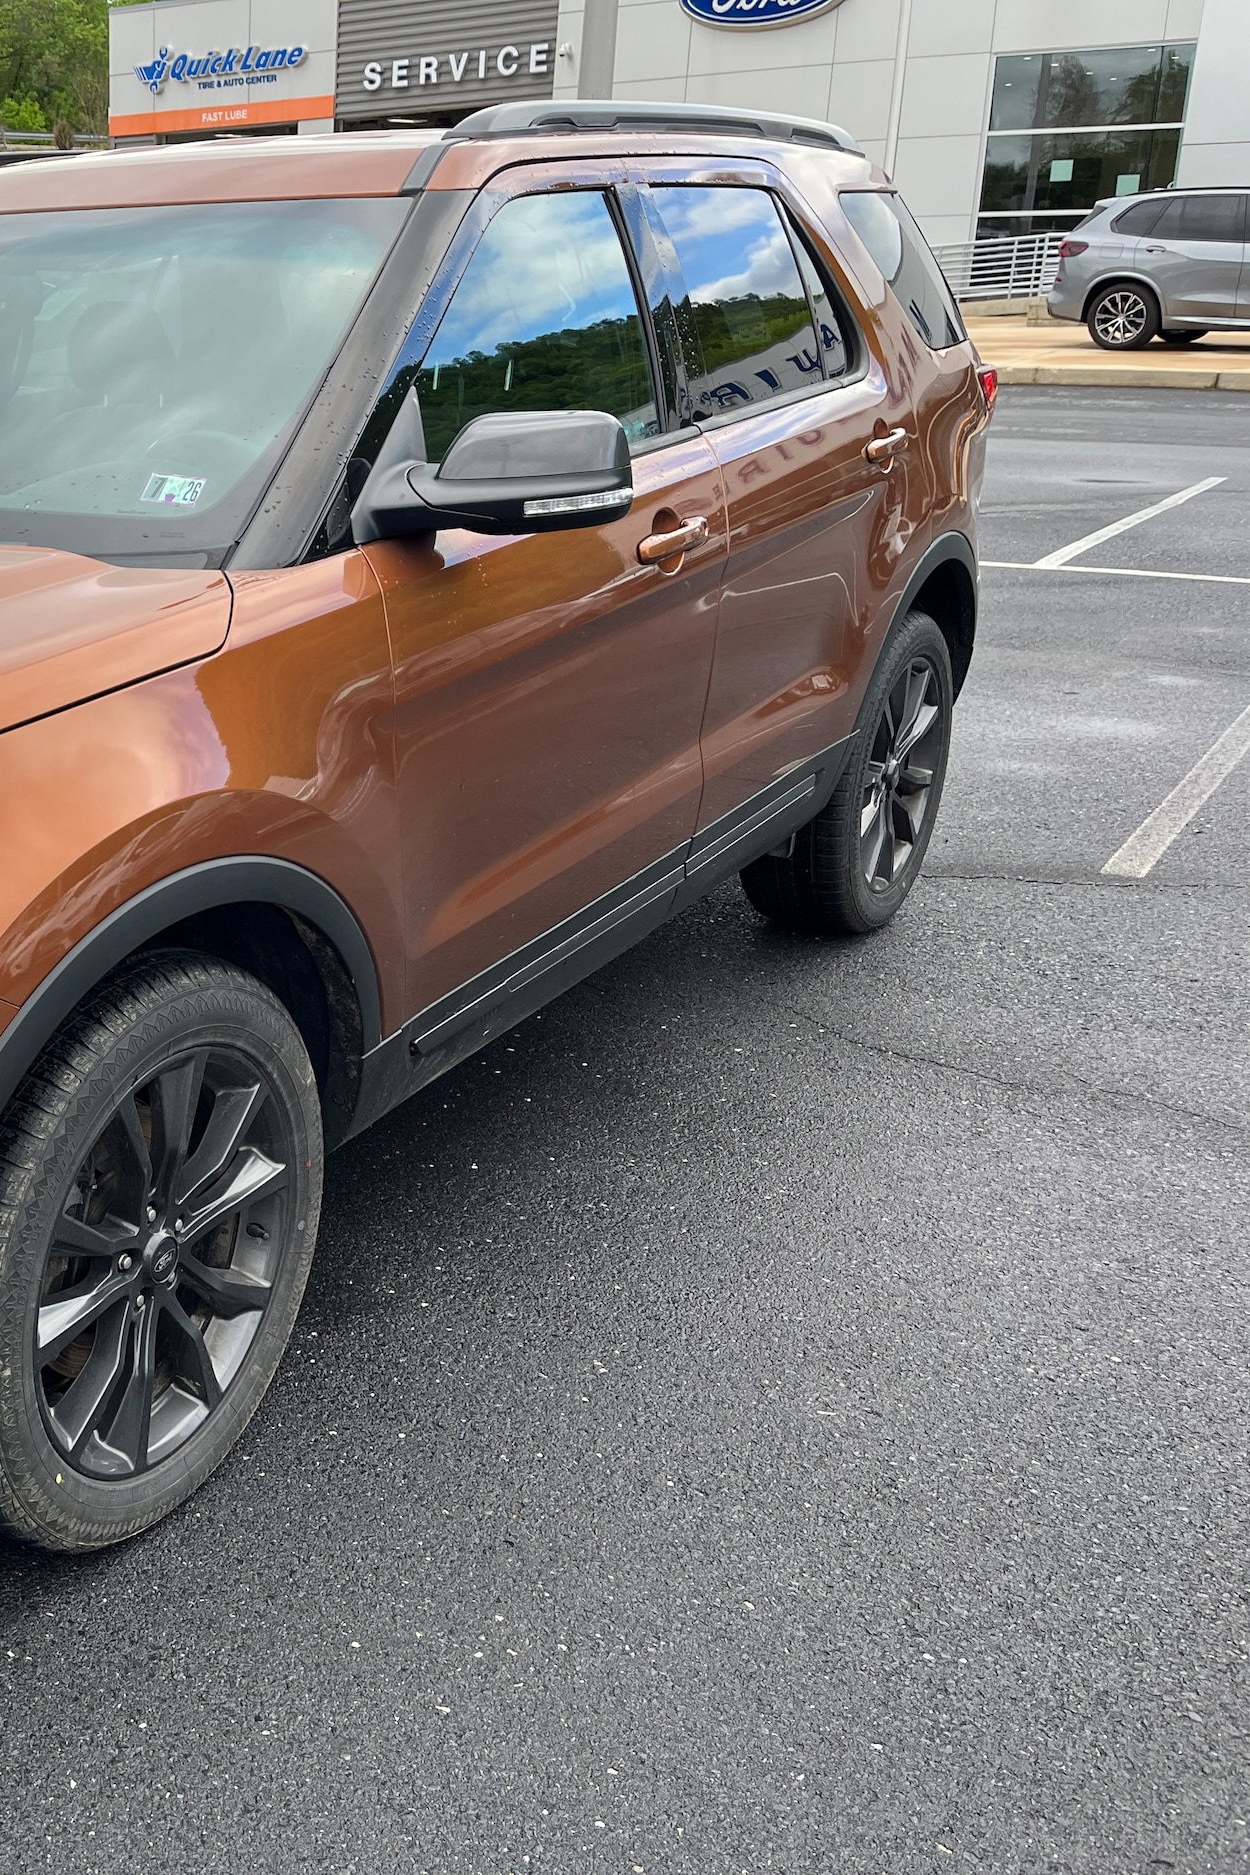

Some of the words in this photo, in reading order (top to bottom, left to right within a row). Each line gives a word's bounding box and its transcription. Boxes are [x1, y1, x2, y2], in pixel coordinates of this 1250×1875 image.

[170, 48, 238, 81] Quick
[240, 46, 303, 71] Lane
[363, 43, 549, 91] SERVICE
[198, 80, 215, 90] TIRE
[216, 79, 222, 88] &
[223, 77, 244, 87] AUTO
[245, 74, 277, 85] CENTER
[202, 112, 223, 122] FAST
[224, 109, 248, 121] LUBE
[182, 480, 202, 502] 26
